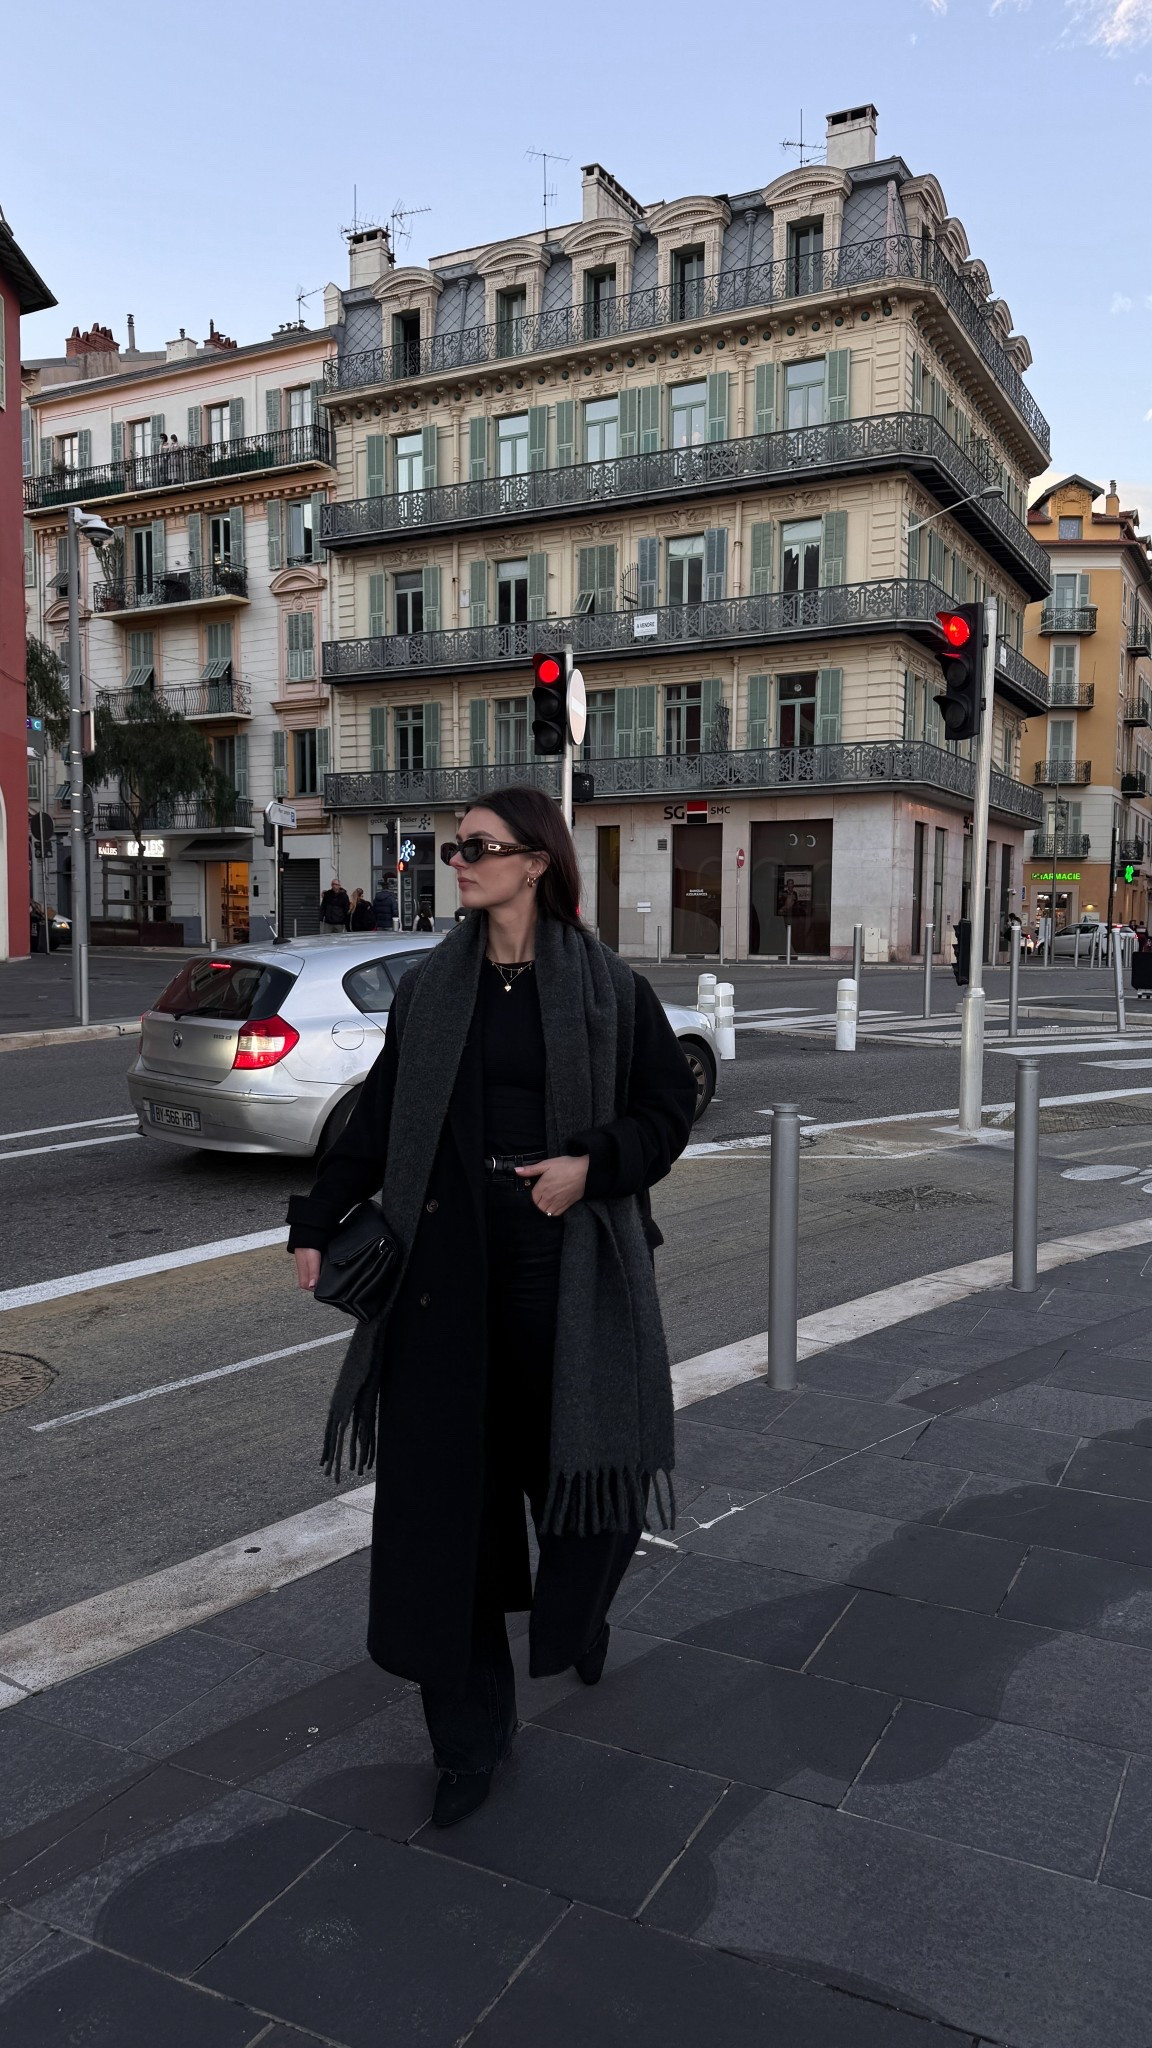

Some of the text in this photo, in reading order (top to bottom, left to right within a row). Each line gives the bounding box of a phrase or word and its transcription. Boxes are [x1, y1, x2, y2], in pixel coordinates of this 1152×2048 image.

[664, 806, 731, 820] SG SMC
[1031, 872, 1081, 880] PHARMACIE
[156, 1106, 194, 1127] BY-566-HR
